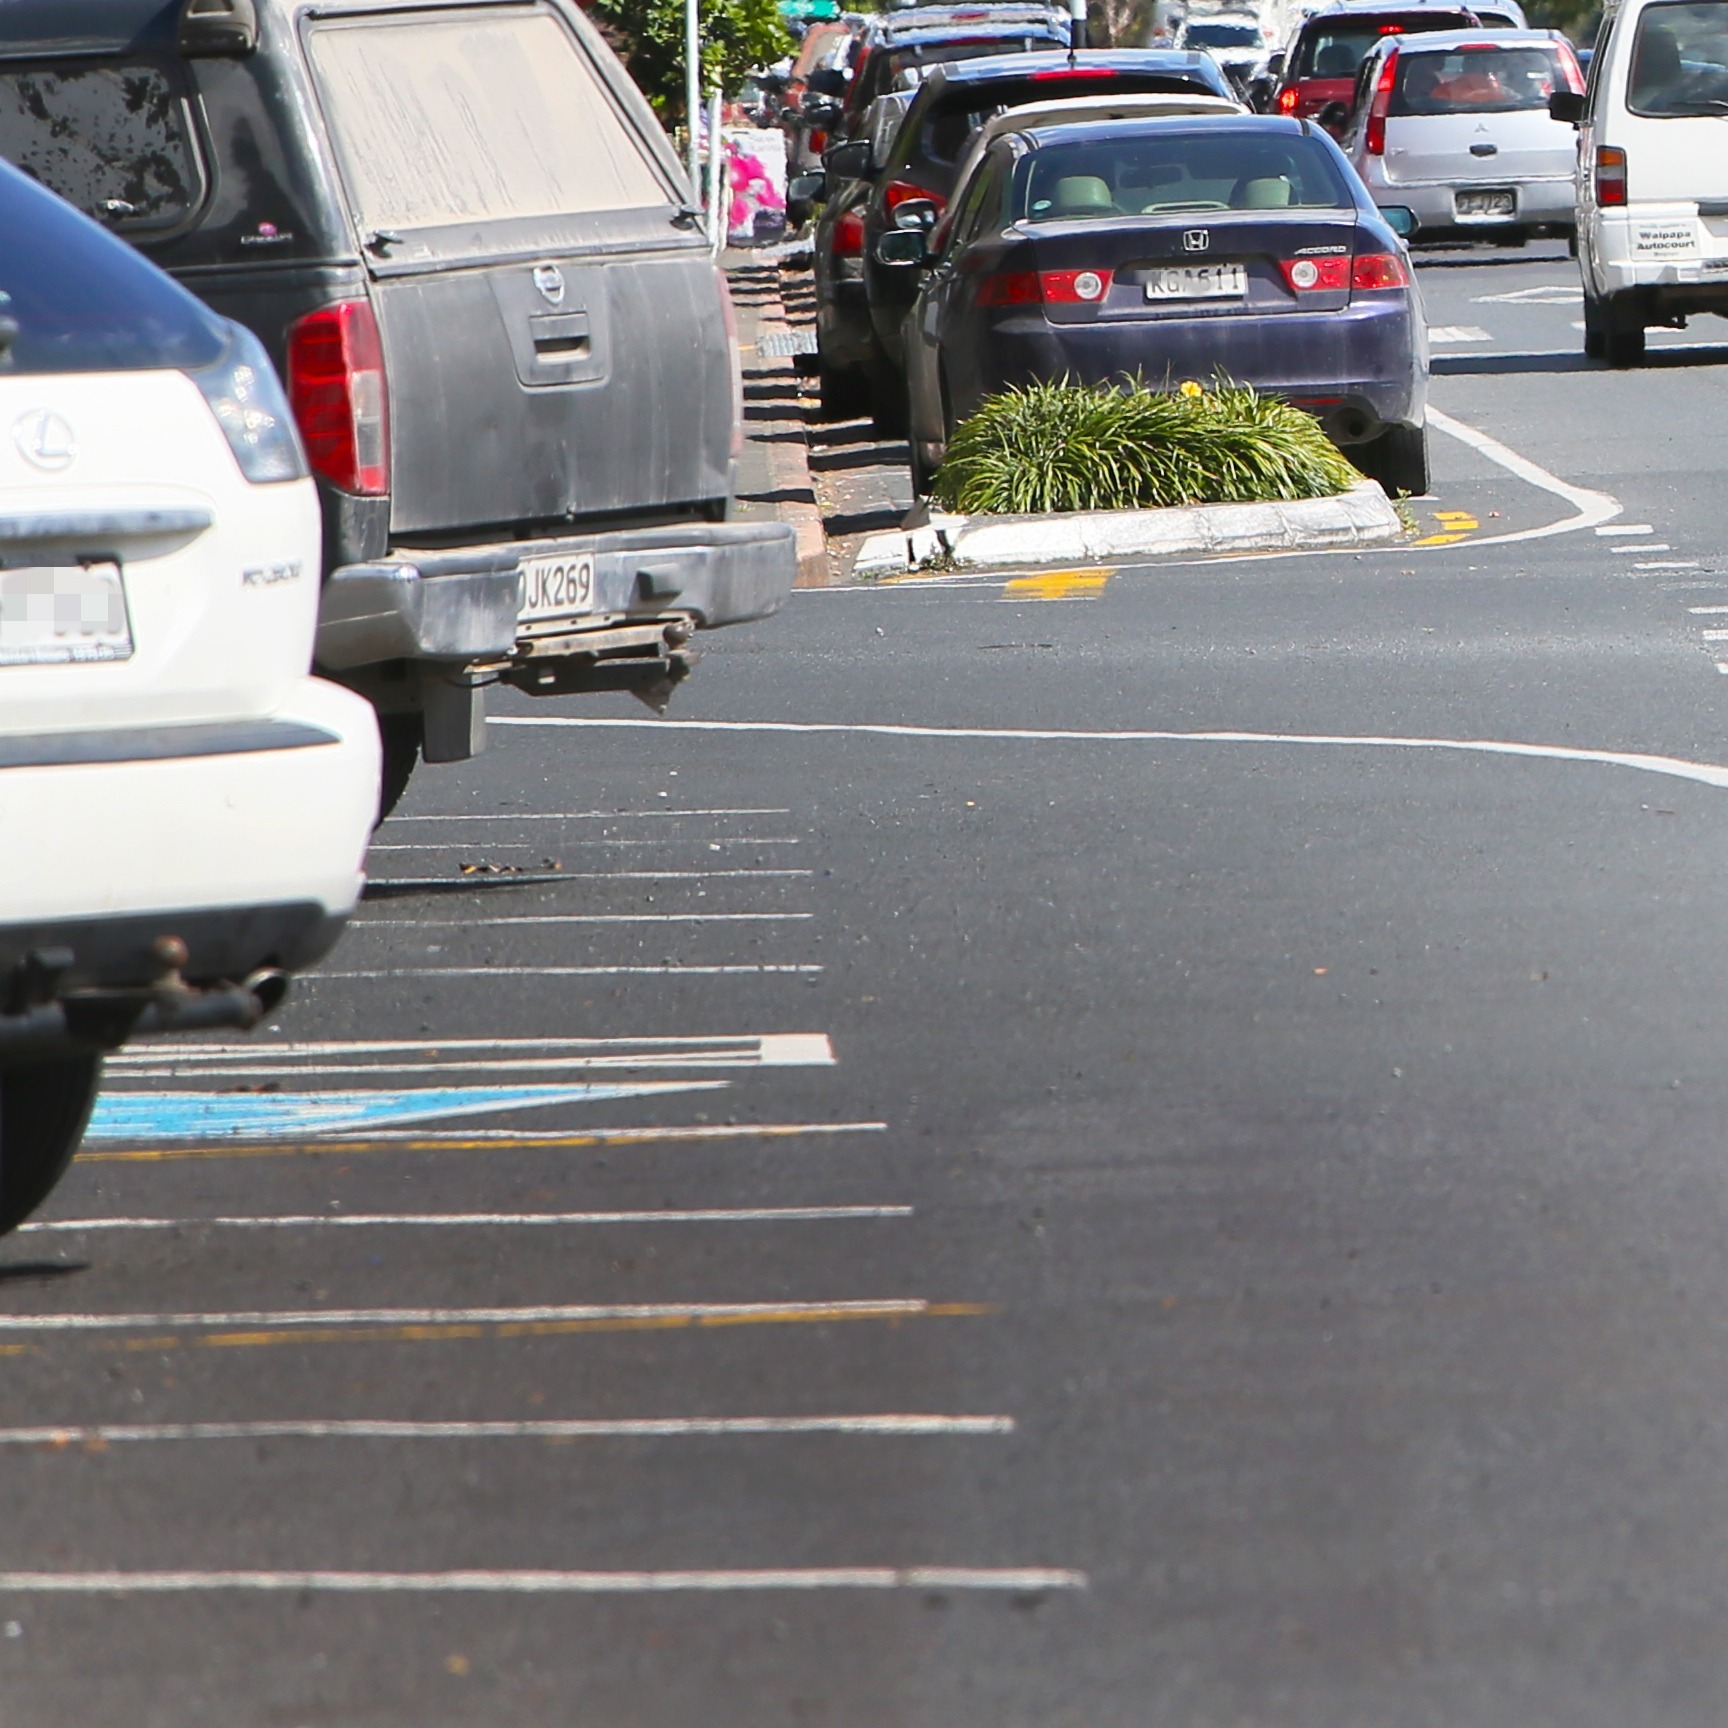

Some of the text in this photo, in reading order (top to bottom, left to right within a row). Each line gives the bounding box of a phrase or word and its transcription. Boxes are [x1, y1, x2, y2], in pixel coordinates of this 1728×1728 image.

[1638, 230, 1692, 241] Waipapa
[1294, 245, 1347, 255] ACCORD
[1636, 239, 1696, 251] Autocourt
